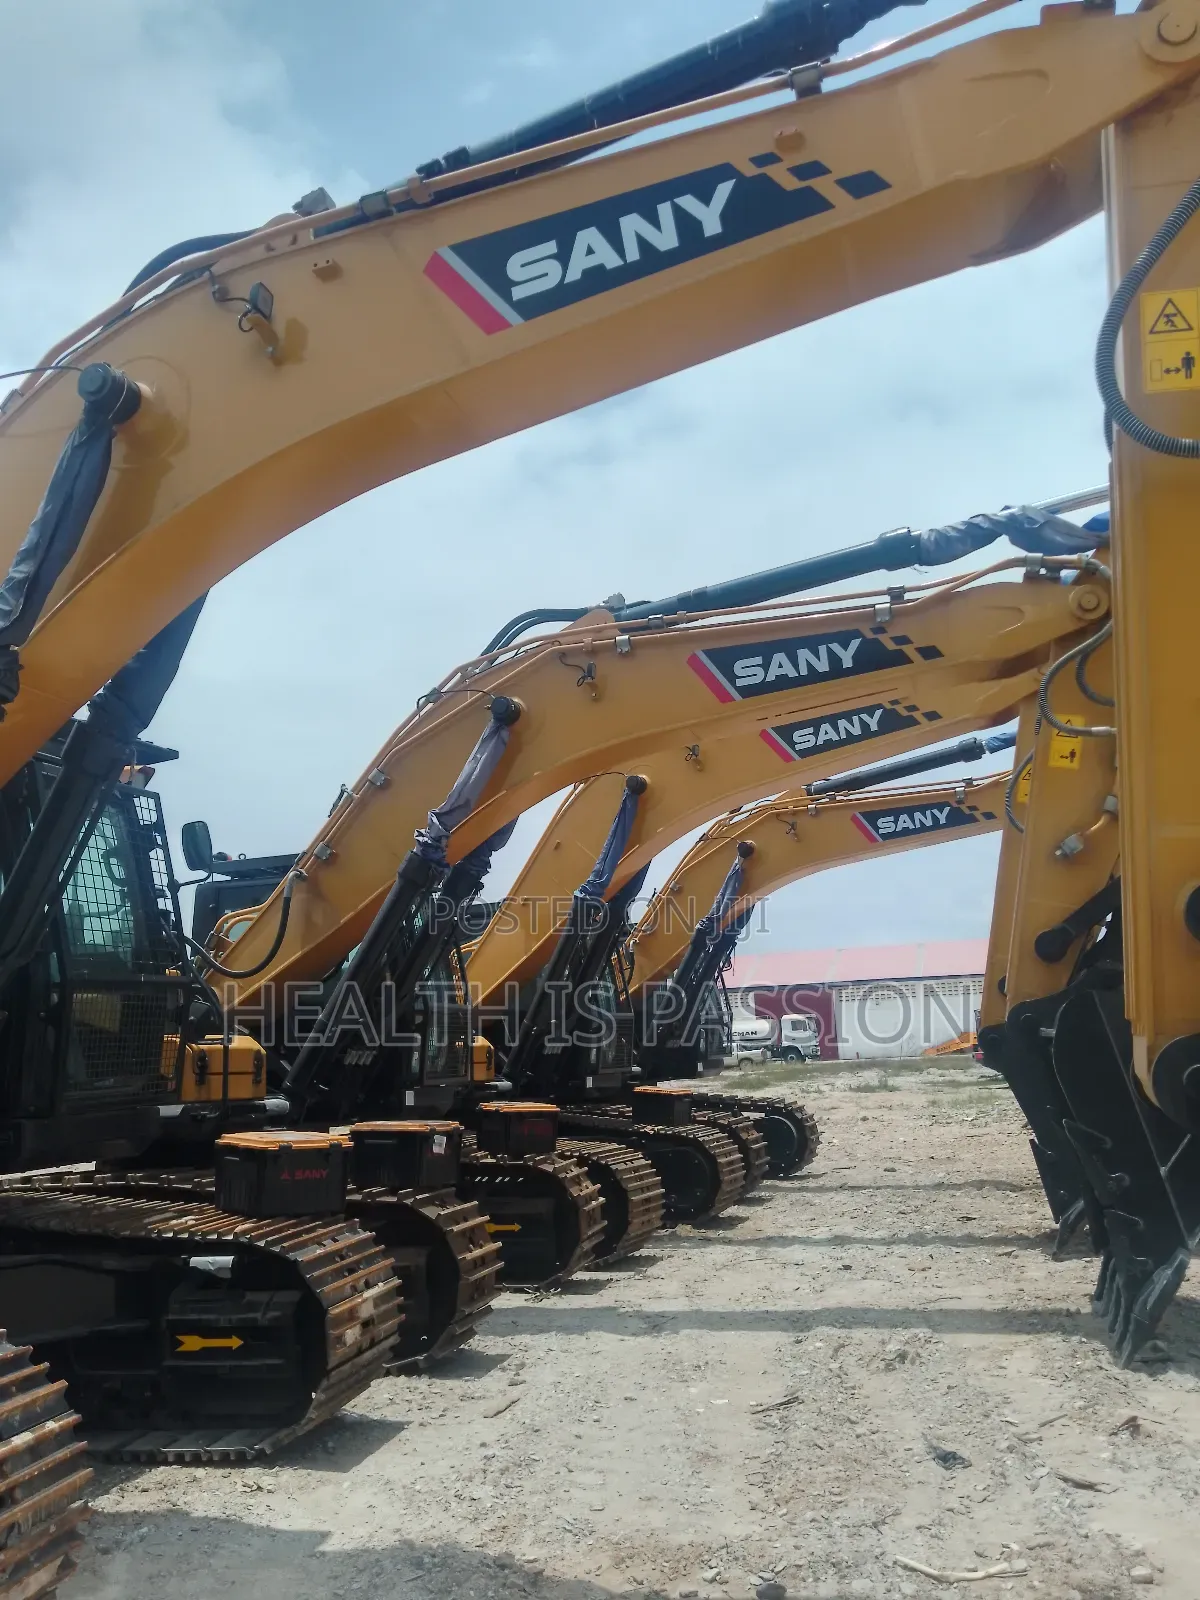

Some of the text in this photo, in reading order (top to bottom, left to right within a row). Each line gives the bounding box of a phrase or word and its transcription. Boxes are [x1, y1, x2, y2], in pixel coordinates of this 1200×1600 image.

[505, 178, 737, 301] SANY
[733, 637, 863, 687] SANY
[792, 708, 884, 751] SANY
[876, 806, 951, 834] SANY
[294, 1168, 330, 1180] SANY
